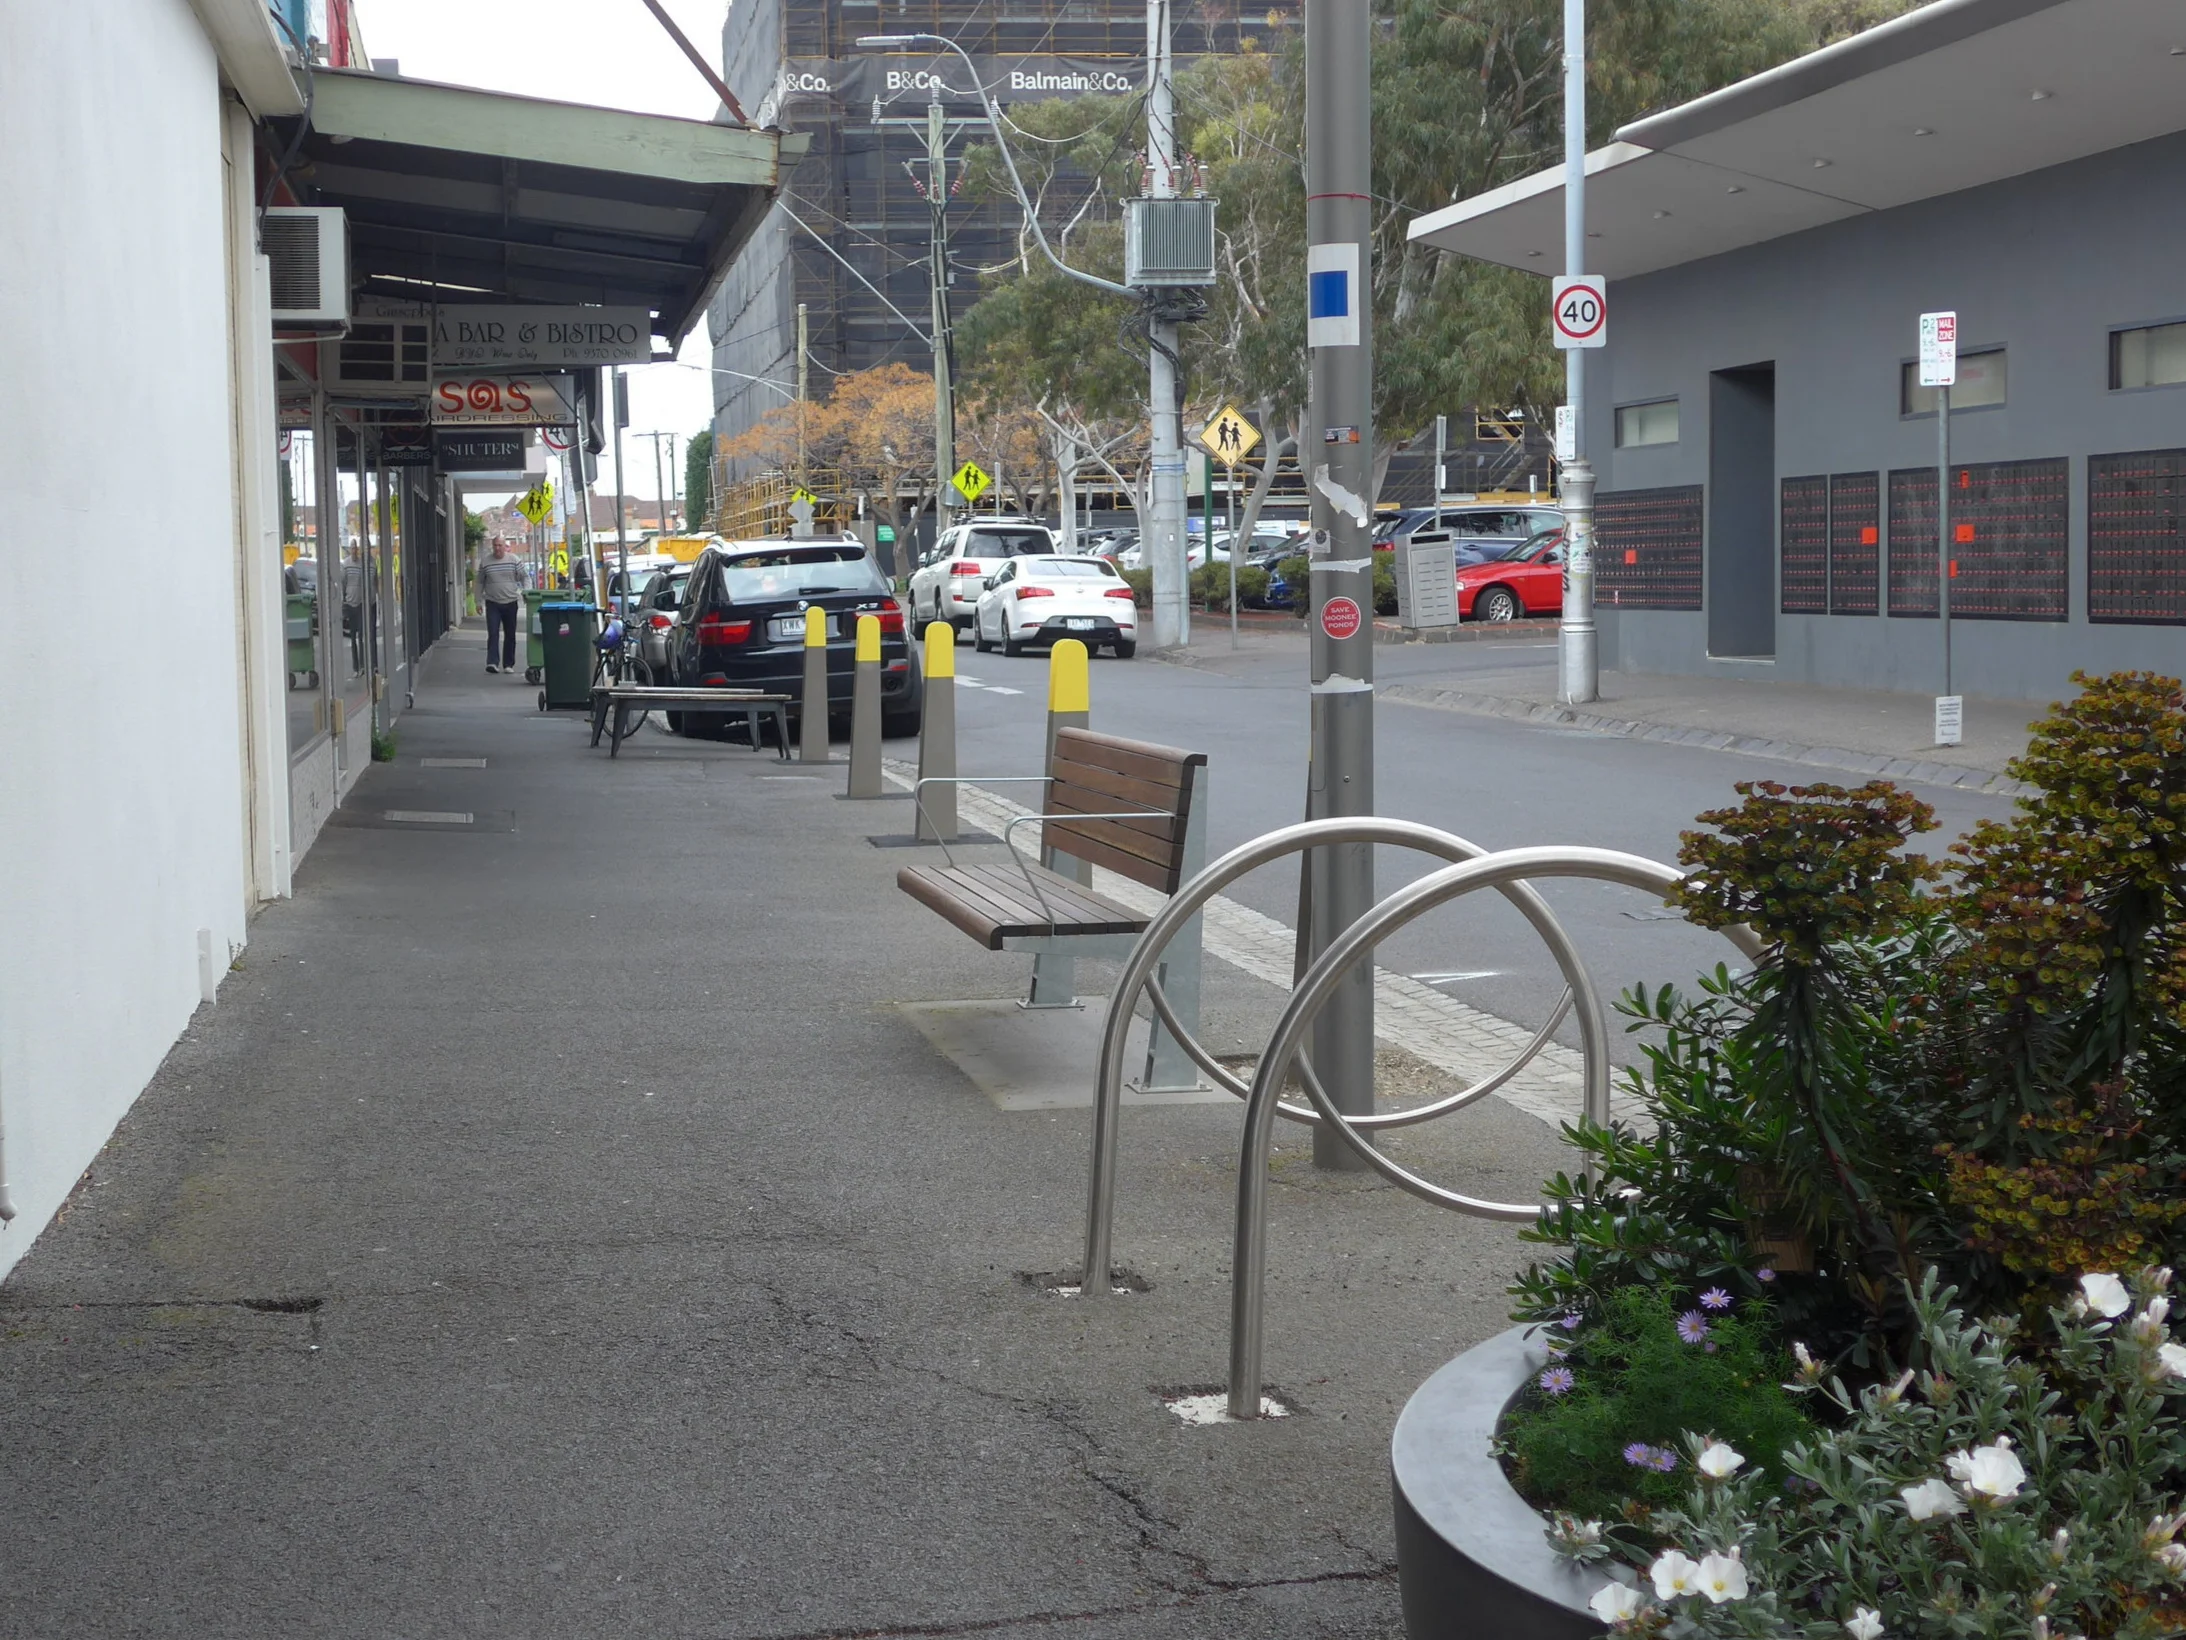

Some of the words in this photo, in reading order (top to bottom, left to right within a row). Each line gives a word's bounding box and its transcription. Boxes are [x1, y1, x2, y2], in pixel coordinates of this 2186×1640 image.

[1011, 71, 1133, 91] Balmain&Co.
[1562, 299, 1597, 323] 40
[458, 322, 505, 344] BAR
[517, 322, 539, 344] &
[546, 322, 639, 345] BISTRO
[383, 451, 432, 460] BARBERS
